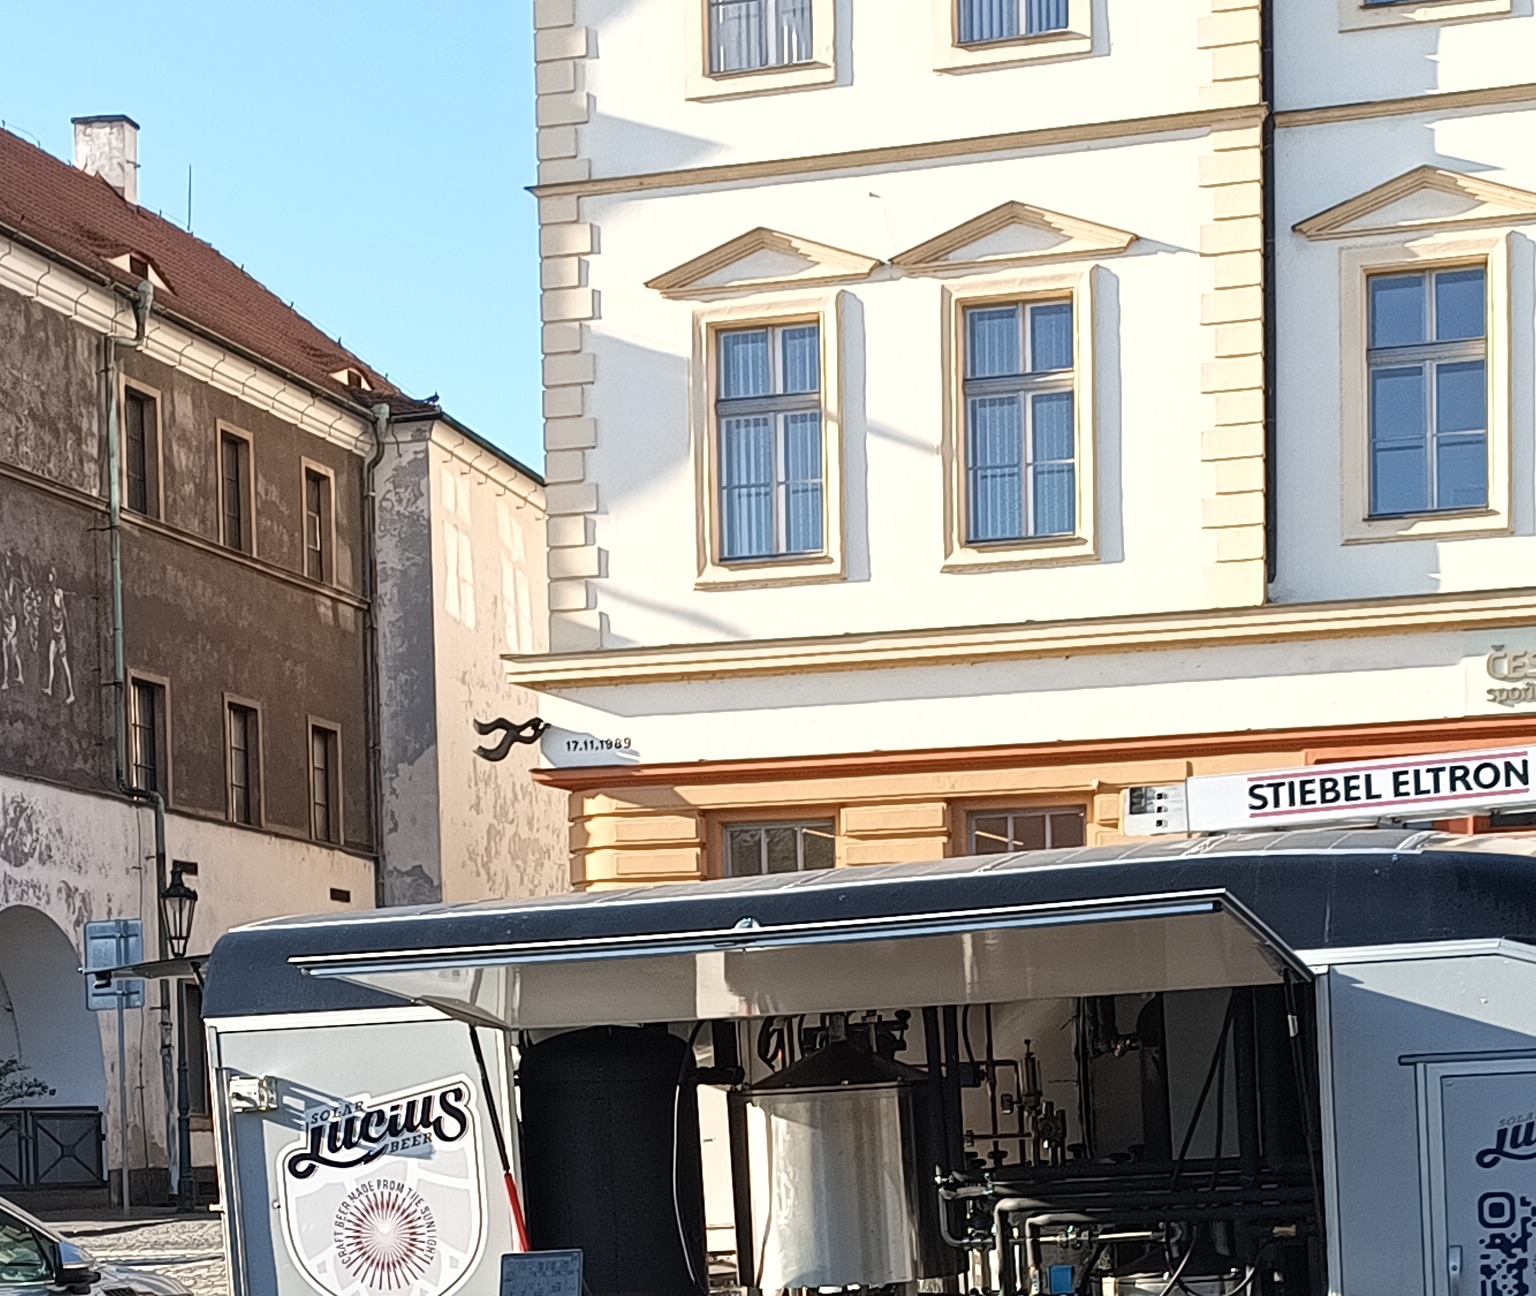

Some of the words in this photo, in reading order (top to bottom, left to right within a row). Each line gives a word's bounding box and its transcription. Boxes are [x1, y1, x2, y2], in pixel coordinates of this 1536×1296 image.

[566, 736, 632, 752] 17.11.1989
[1248, 773, 1382, 811] STIEBEL
[1392, 758, 1530, 799] ELTRON
[311, 1101, 364, 1124] SOLAR
[389, 1132, 434, 1153] BEER
[347, 1181, 374, 1203] MADE
[376, 1179, 405, 1194] FROM
[405, 1187, 426, 1208] THE
[334, 1200, 352, 1229] BEER
[334, 1230, 352, 1265] CRAFT
